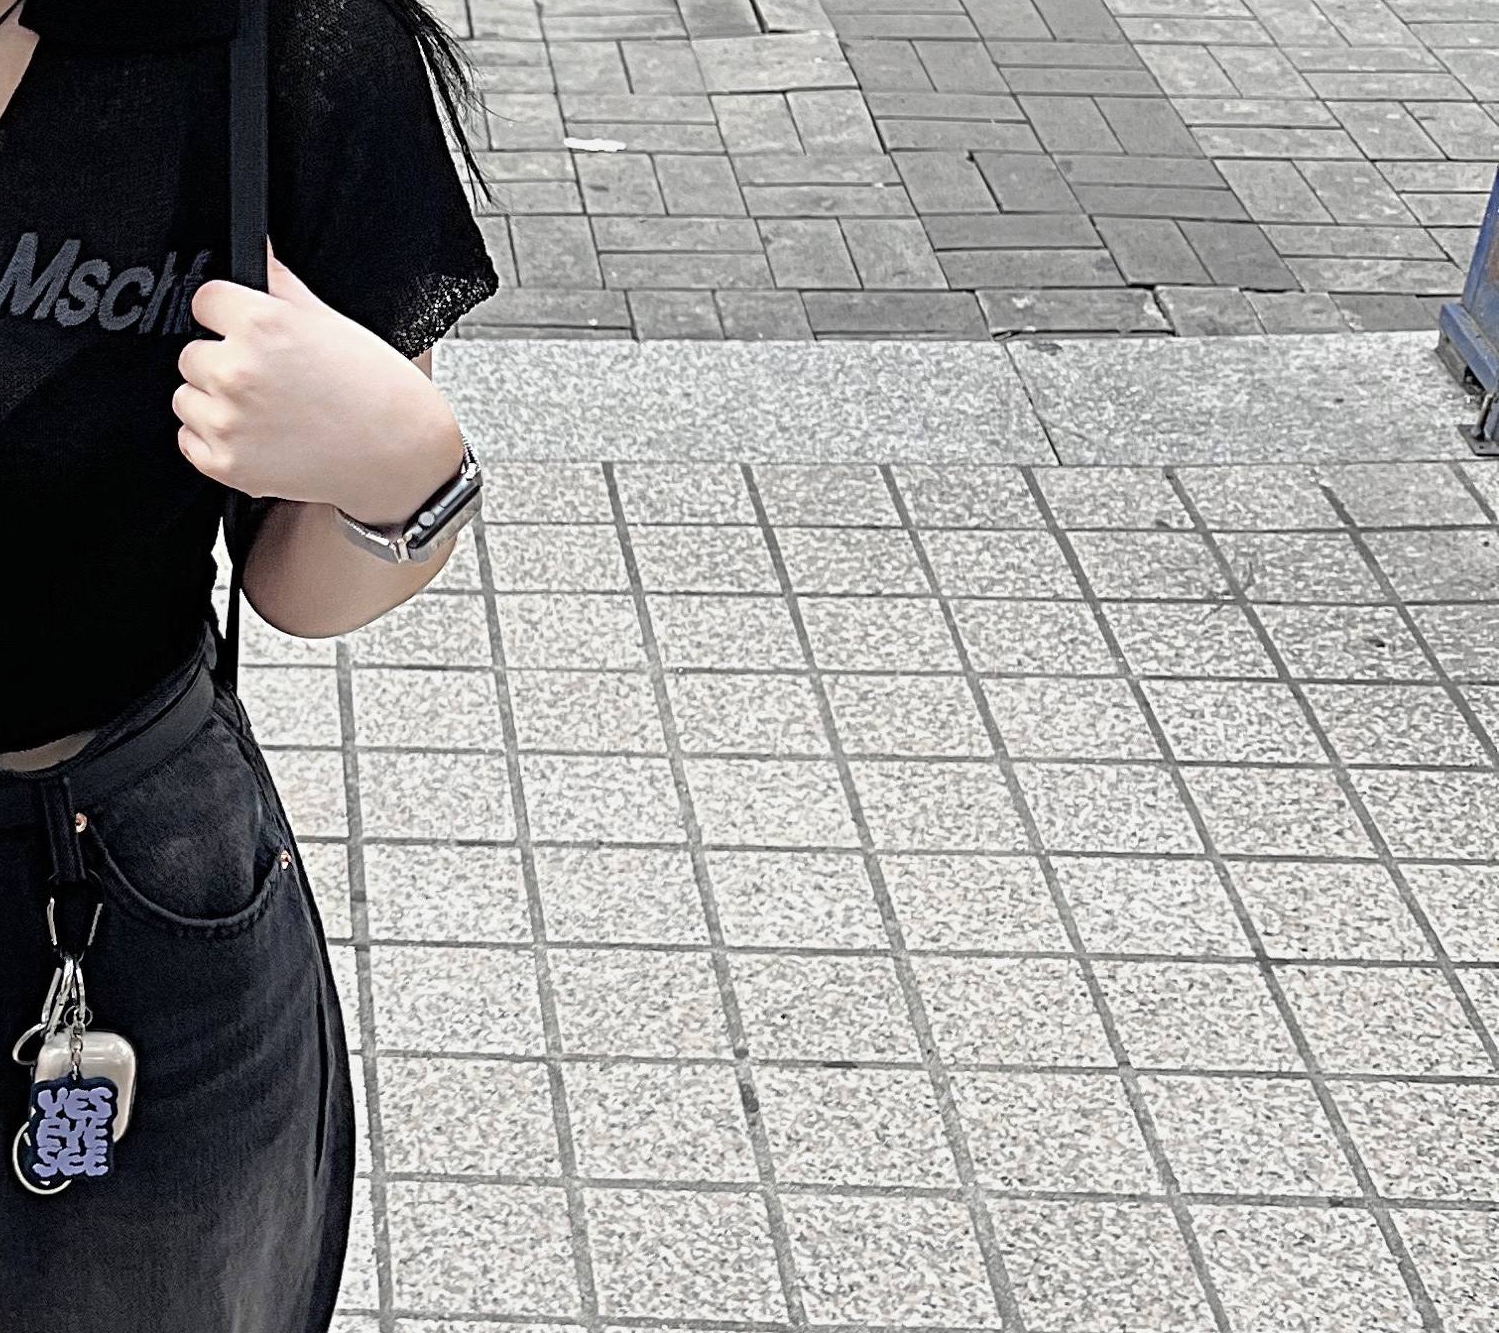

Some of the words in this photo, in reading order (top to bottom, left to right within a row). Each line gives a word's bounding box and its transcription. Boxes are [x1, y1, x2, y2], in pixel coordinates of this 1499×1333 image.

[37, 1086, 113, 1120] YES
[36, 1117, 109, 1152] EYE
[32, 1147, 109, 1178] SEE
